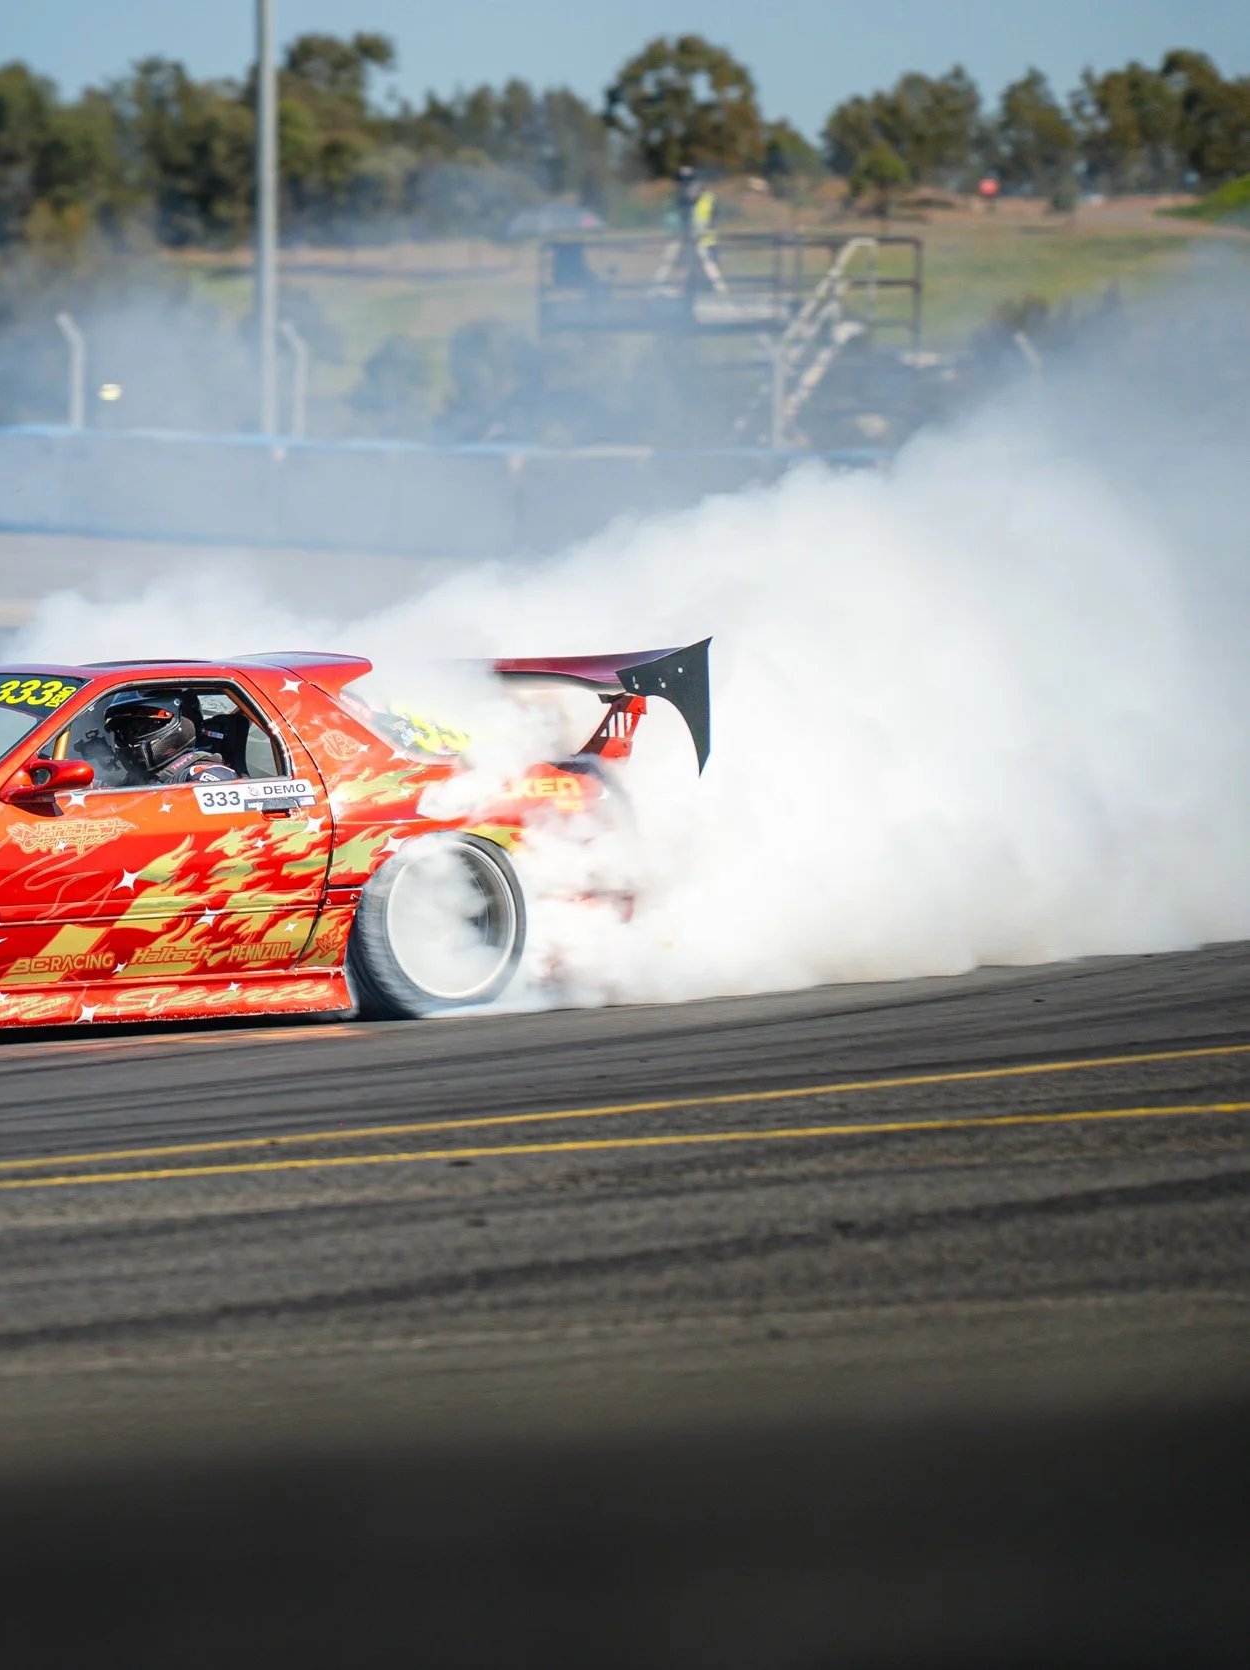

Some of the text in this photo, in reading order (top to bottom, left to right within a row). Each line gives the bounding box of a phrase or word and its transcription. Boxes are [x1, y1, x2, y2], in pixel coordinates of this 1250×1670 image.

[45, 686, 77, 708] DEMO
[263, 783, 306, 795] DEMO
[202, 791, 241, 808] 333
[131, 945, 212, 964] Haltech
[229, 943, 291, 961] PENNZOIL
